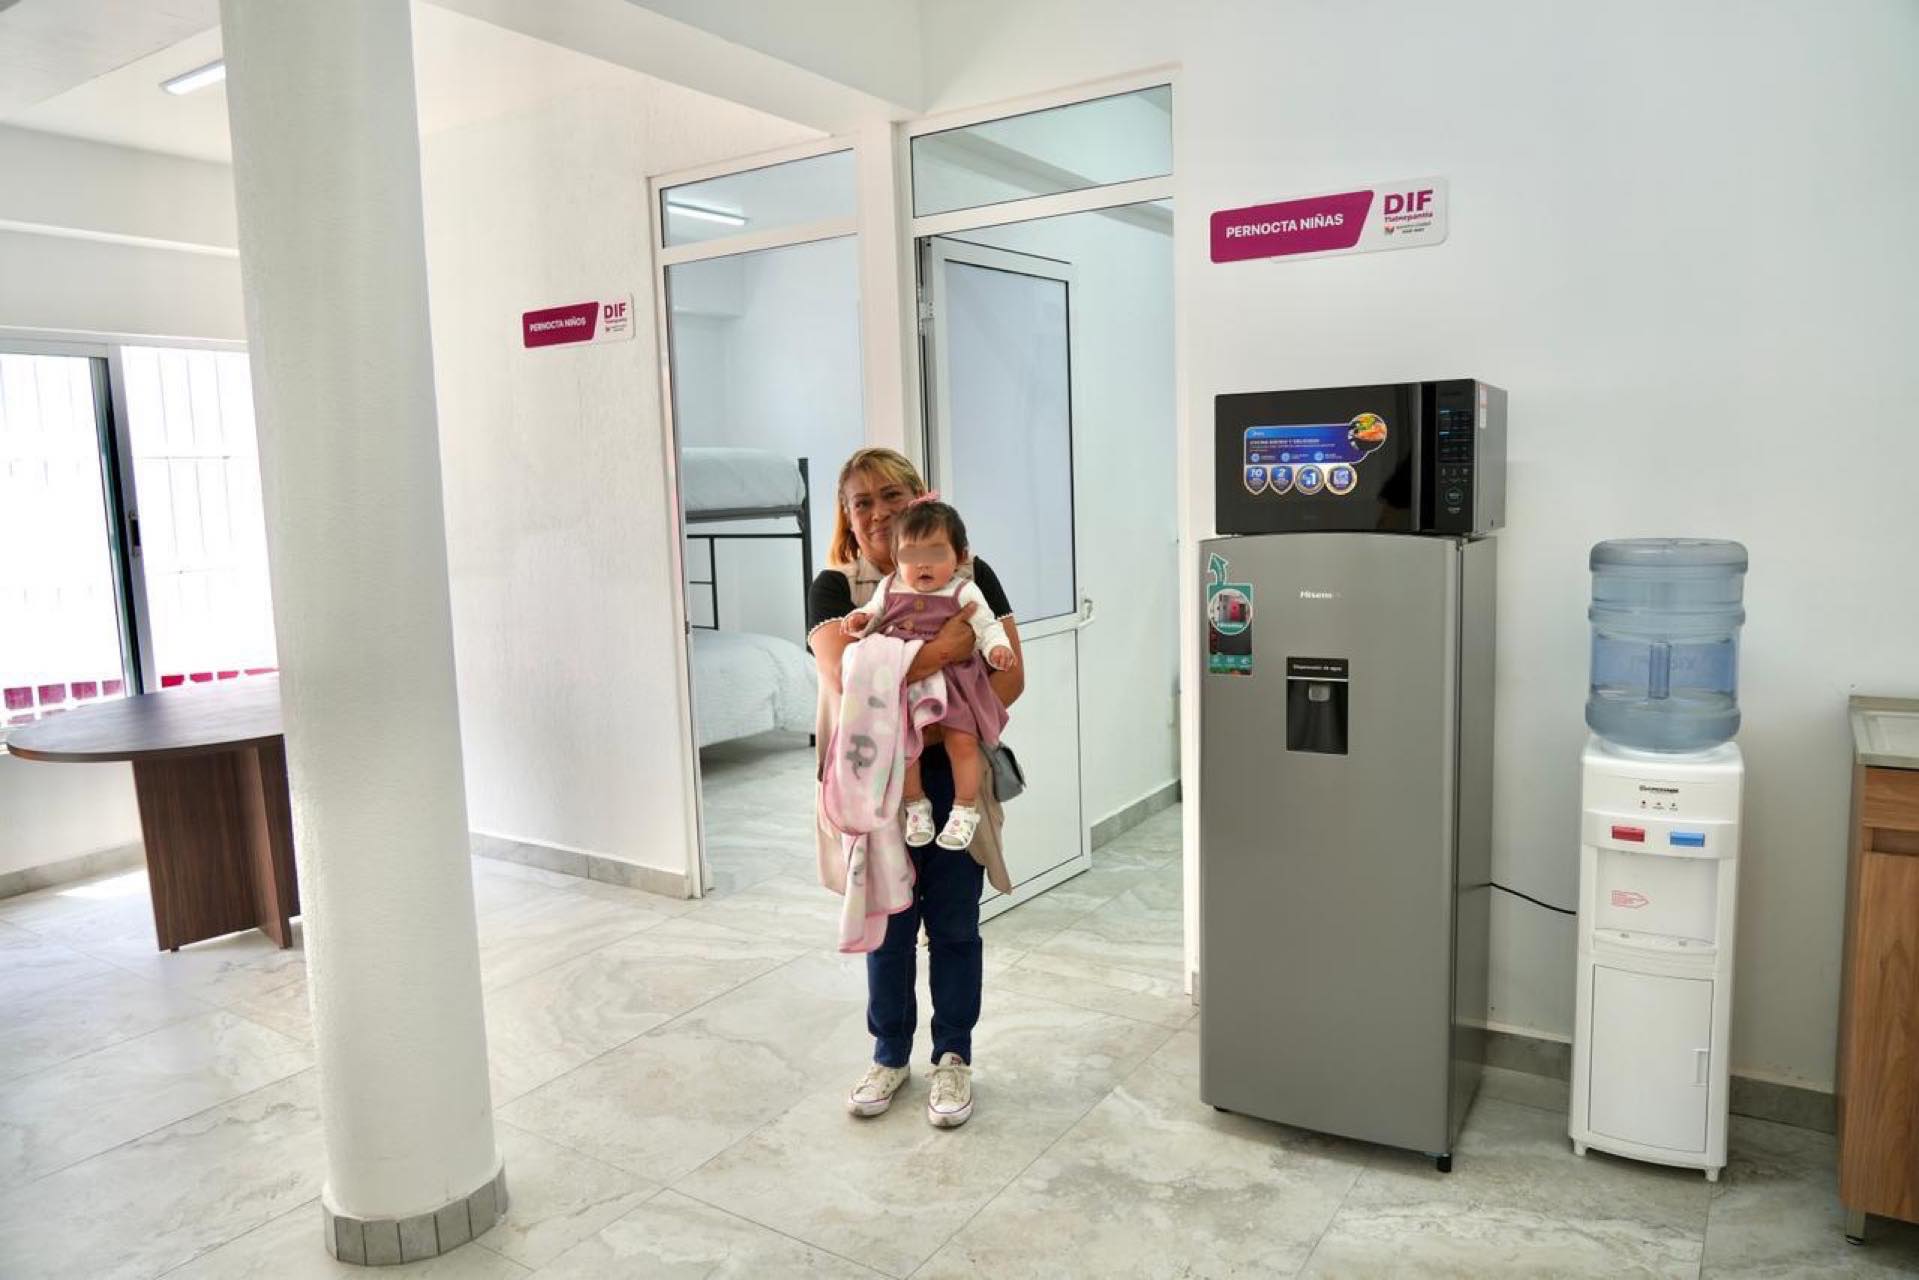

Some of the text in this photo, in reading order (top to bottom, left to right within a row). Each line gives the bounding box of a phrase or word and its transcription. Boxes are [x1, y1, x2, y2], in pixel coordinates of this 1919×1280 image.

[1384, 190, 1433, 215] DIF
[1226, 213, 1344, 239] PERNOCTA NIÑAS
[604, 303, 626, 319] DIF
[529, 316, 586, 332] PERNOCTA NIÑOS
[1300, 590, 1342, 599] Hisen
